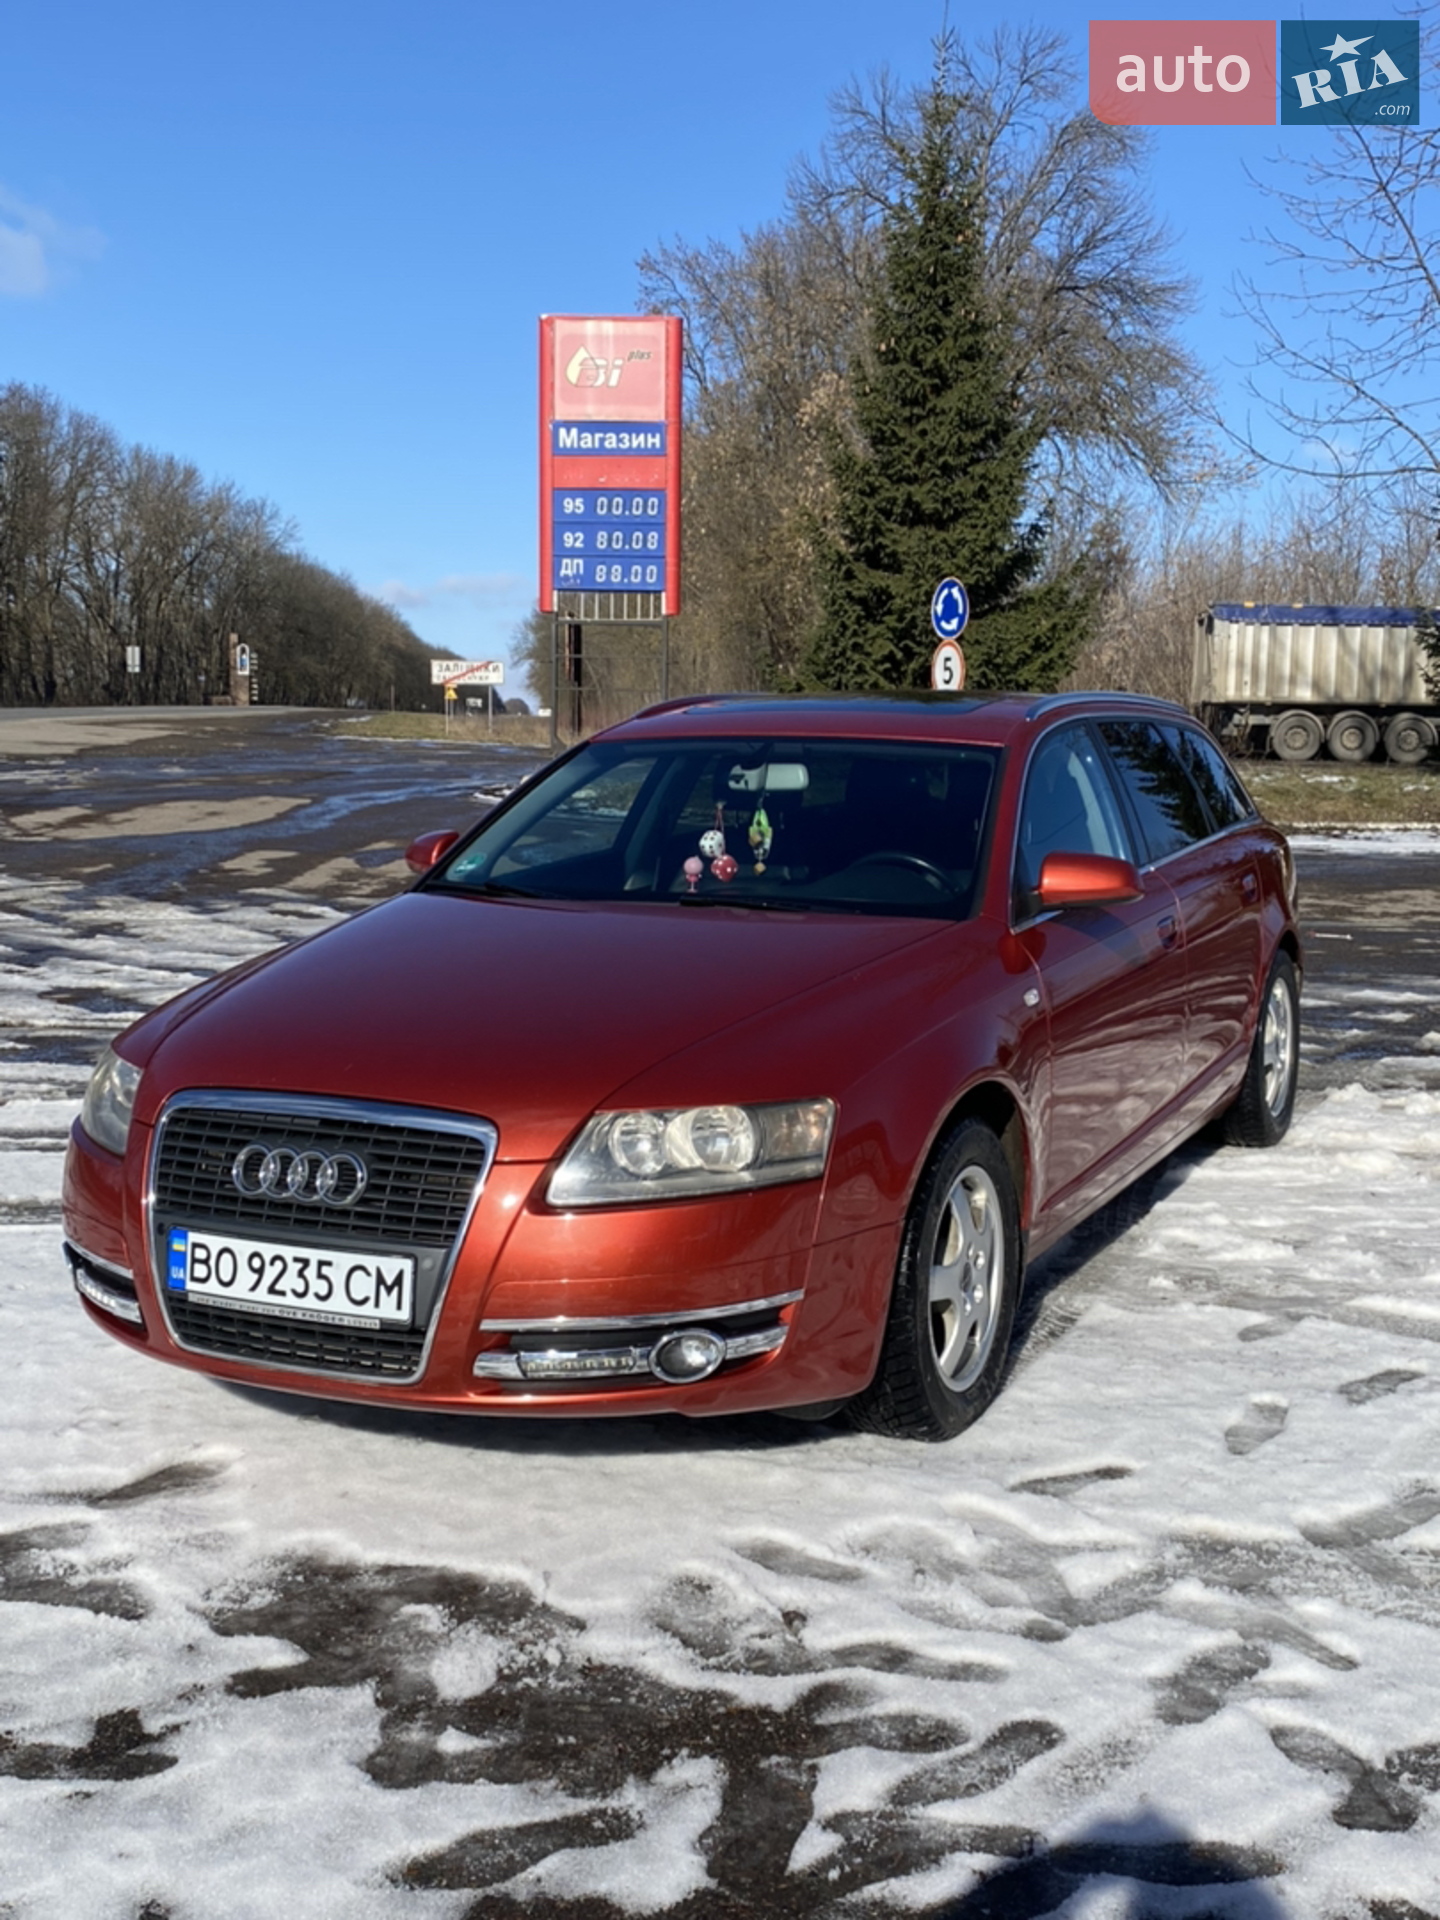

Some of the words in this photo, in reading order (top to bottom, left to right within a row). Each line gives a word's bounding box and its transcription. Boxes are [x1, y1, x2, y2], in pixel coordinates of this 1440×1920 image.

[558, 427, 661, 449] Магазин
[563, 497, 585, 515] 95
[563, 531, 585, 549] 92
[560, 558, 584, 578] ДП
[942, 657, 954, 685] 5
[171, 1266, 185, 1280] UA
[189, 1241, 238, 1288] BO
[246, 1250, 334, 1302] 9235
[344, 1264, 405, 1312] CM
